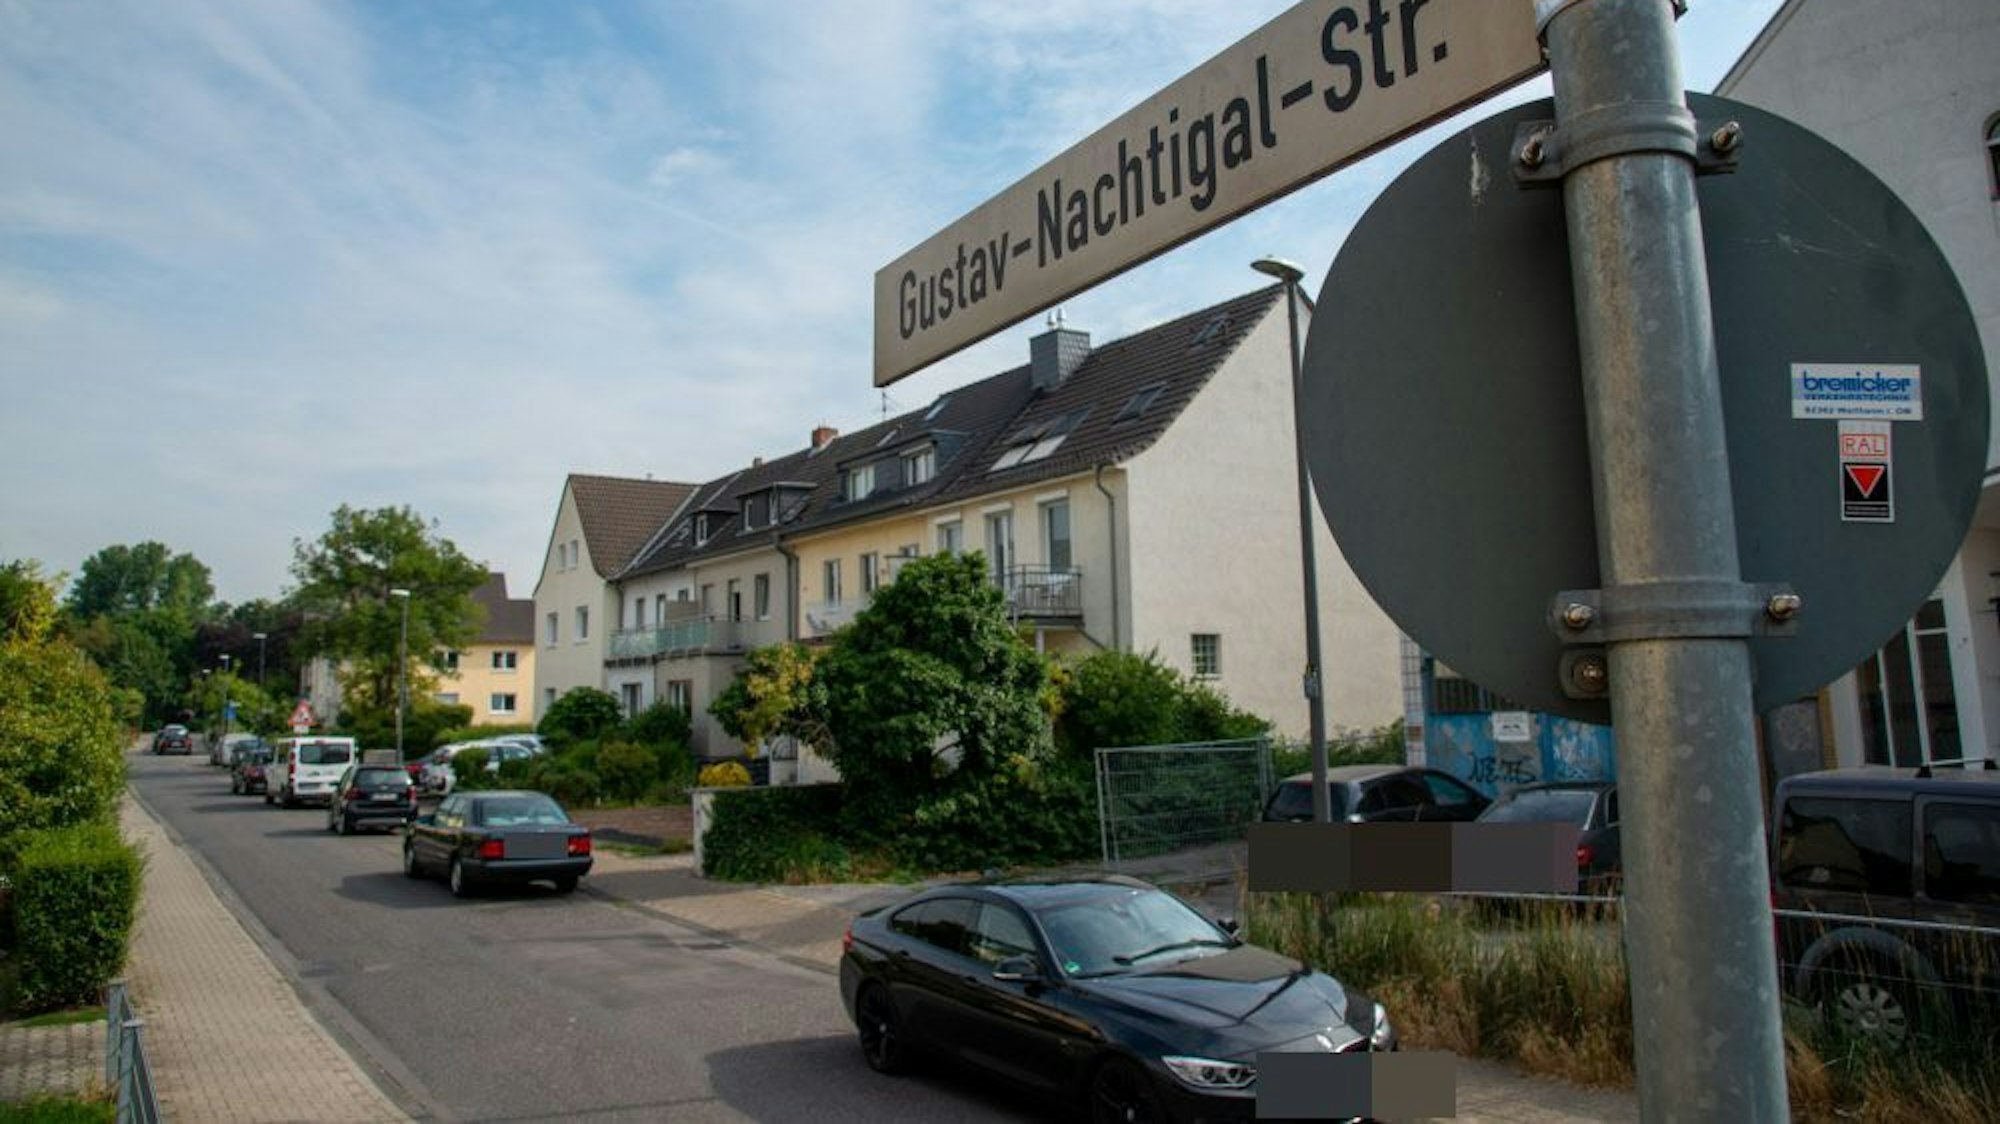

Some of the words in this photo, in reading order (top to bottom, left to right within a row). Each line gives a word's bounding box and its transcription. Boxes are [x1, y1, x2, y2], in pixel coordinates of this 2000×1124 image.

[900, 0, 1447, 339] Gustav-Nachtigal-Str.
[1803, 370, 1912, 392] bremicker
[1845, 437, 1884, 453] RAL
